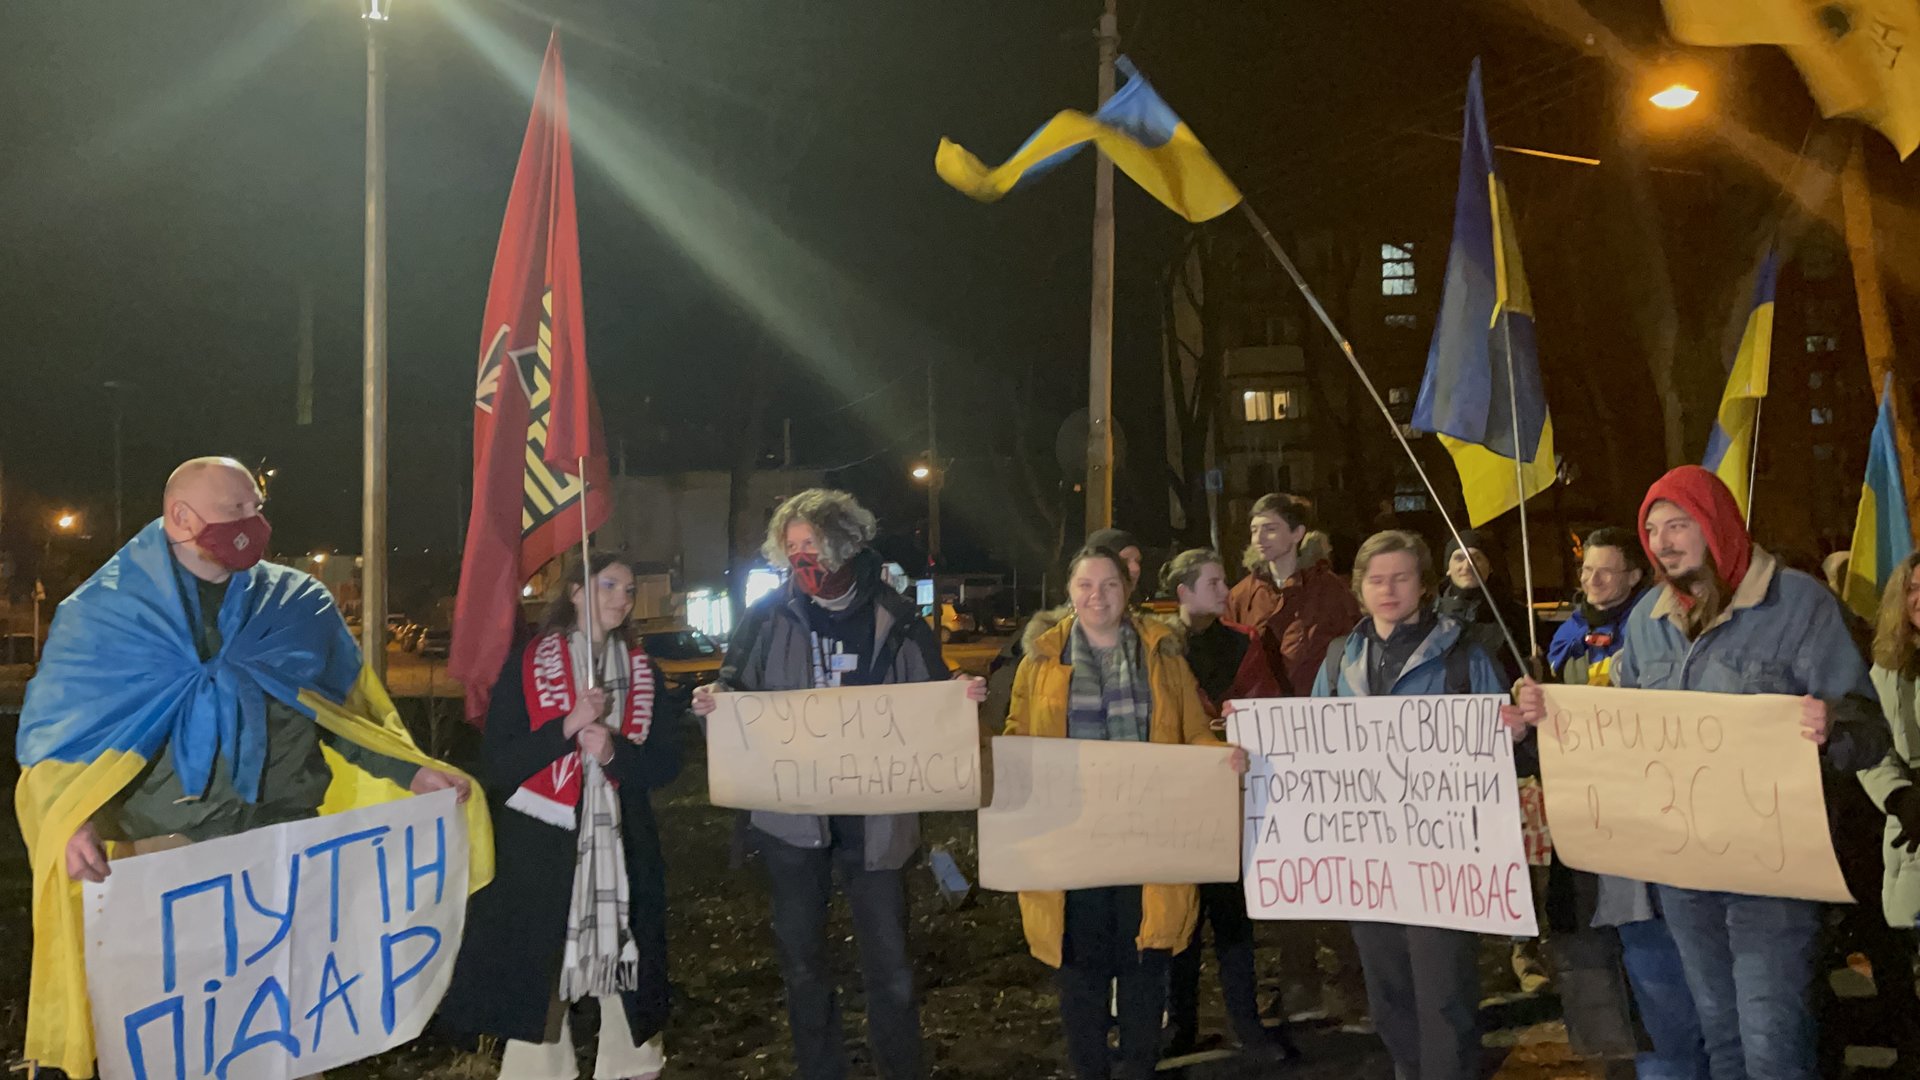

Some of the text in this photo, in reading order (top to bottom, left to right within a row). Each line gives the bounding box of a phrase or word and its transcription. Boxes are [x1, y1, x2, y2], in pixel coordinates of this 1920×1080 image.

[1399, 698, 1509, 763] СВОБОДА
[1554, 704, 1724, 754] ВІРИМО
[772, 752, 976, 801] ПІДАРАСИ
[1247, 815, 1281, 844] ТА
[1304, 811, 1397, 845] СМЕРТЬ
[1644, 760, 1786, 873] ЗСУ
[1256, 856, 1523, 921] БОРОТЬБА ТРИВАЄ
